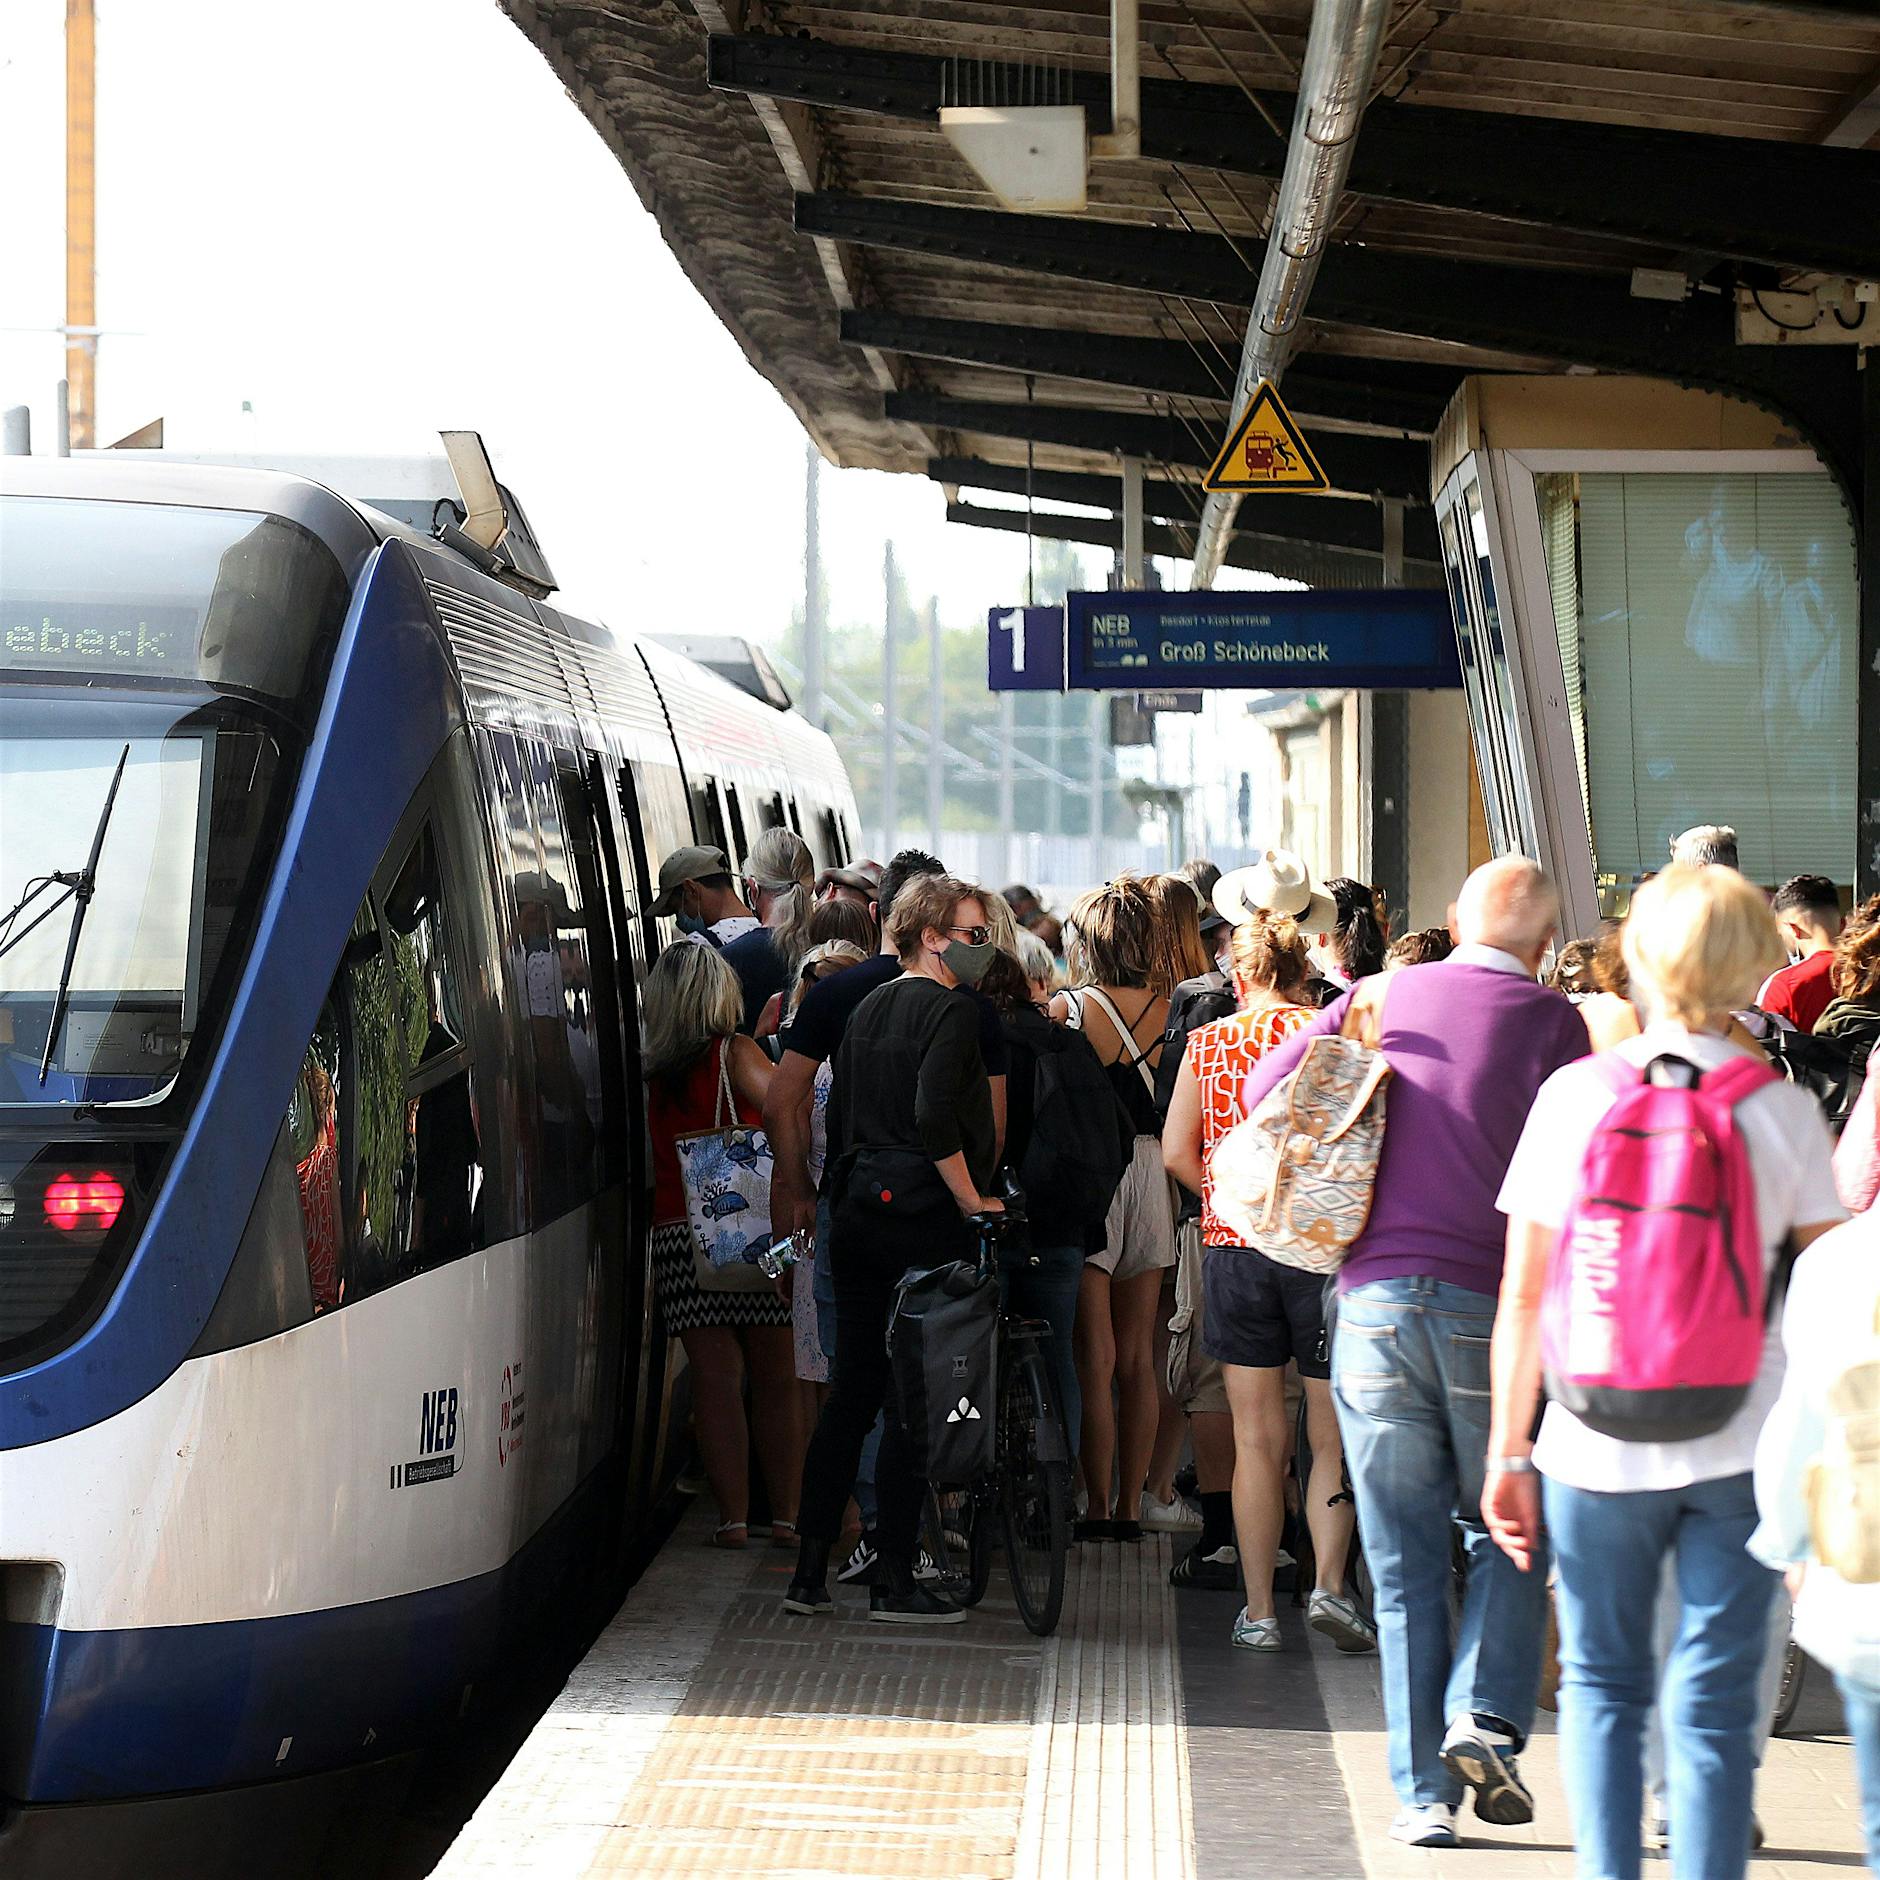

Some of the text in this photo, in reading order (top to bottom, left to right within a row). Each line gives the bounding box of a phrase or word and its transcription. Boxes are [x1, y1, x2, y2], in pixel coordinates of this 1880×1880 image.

[5, 616, 174, 657] ebeck
[999, 608, 1026, 673] 1
[1092, 614, 1130, 635] NEB
[1160, 640, 1330, 662] Groß Schönebeck
[420, 1387, 459, 1455] NEB
